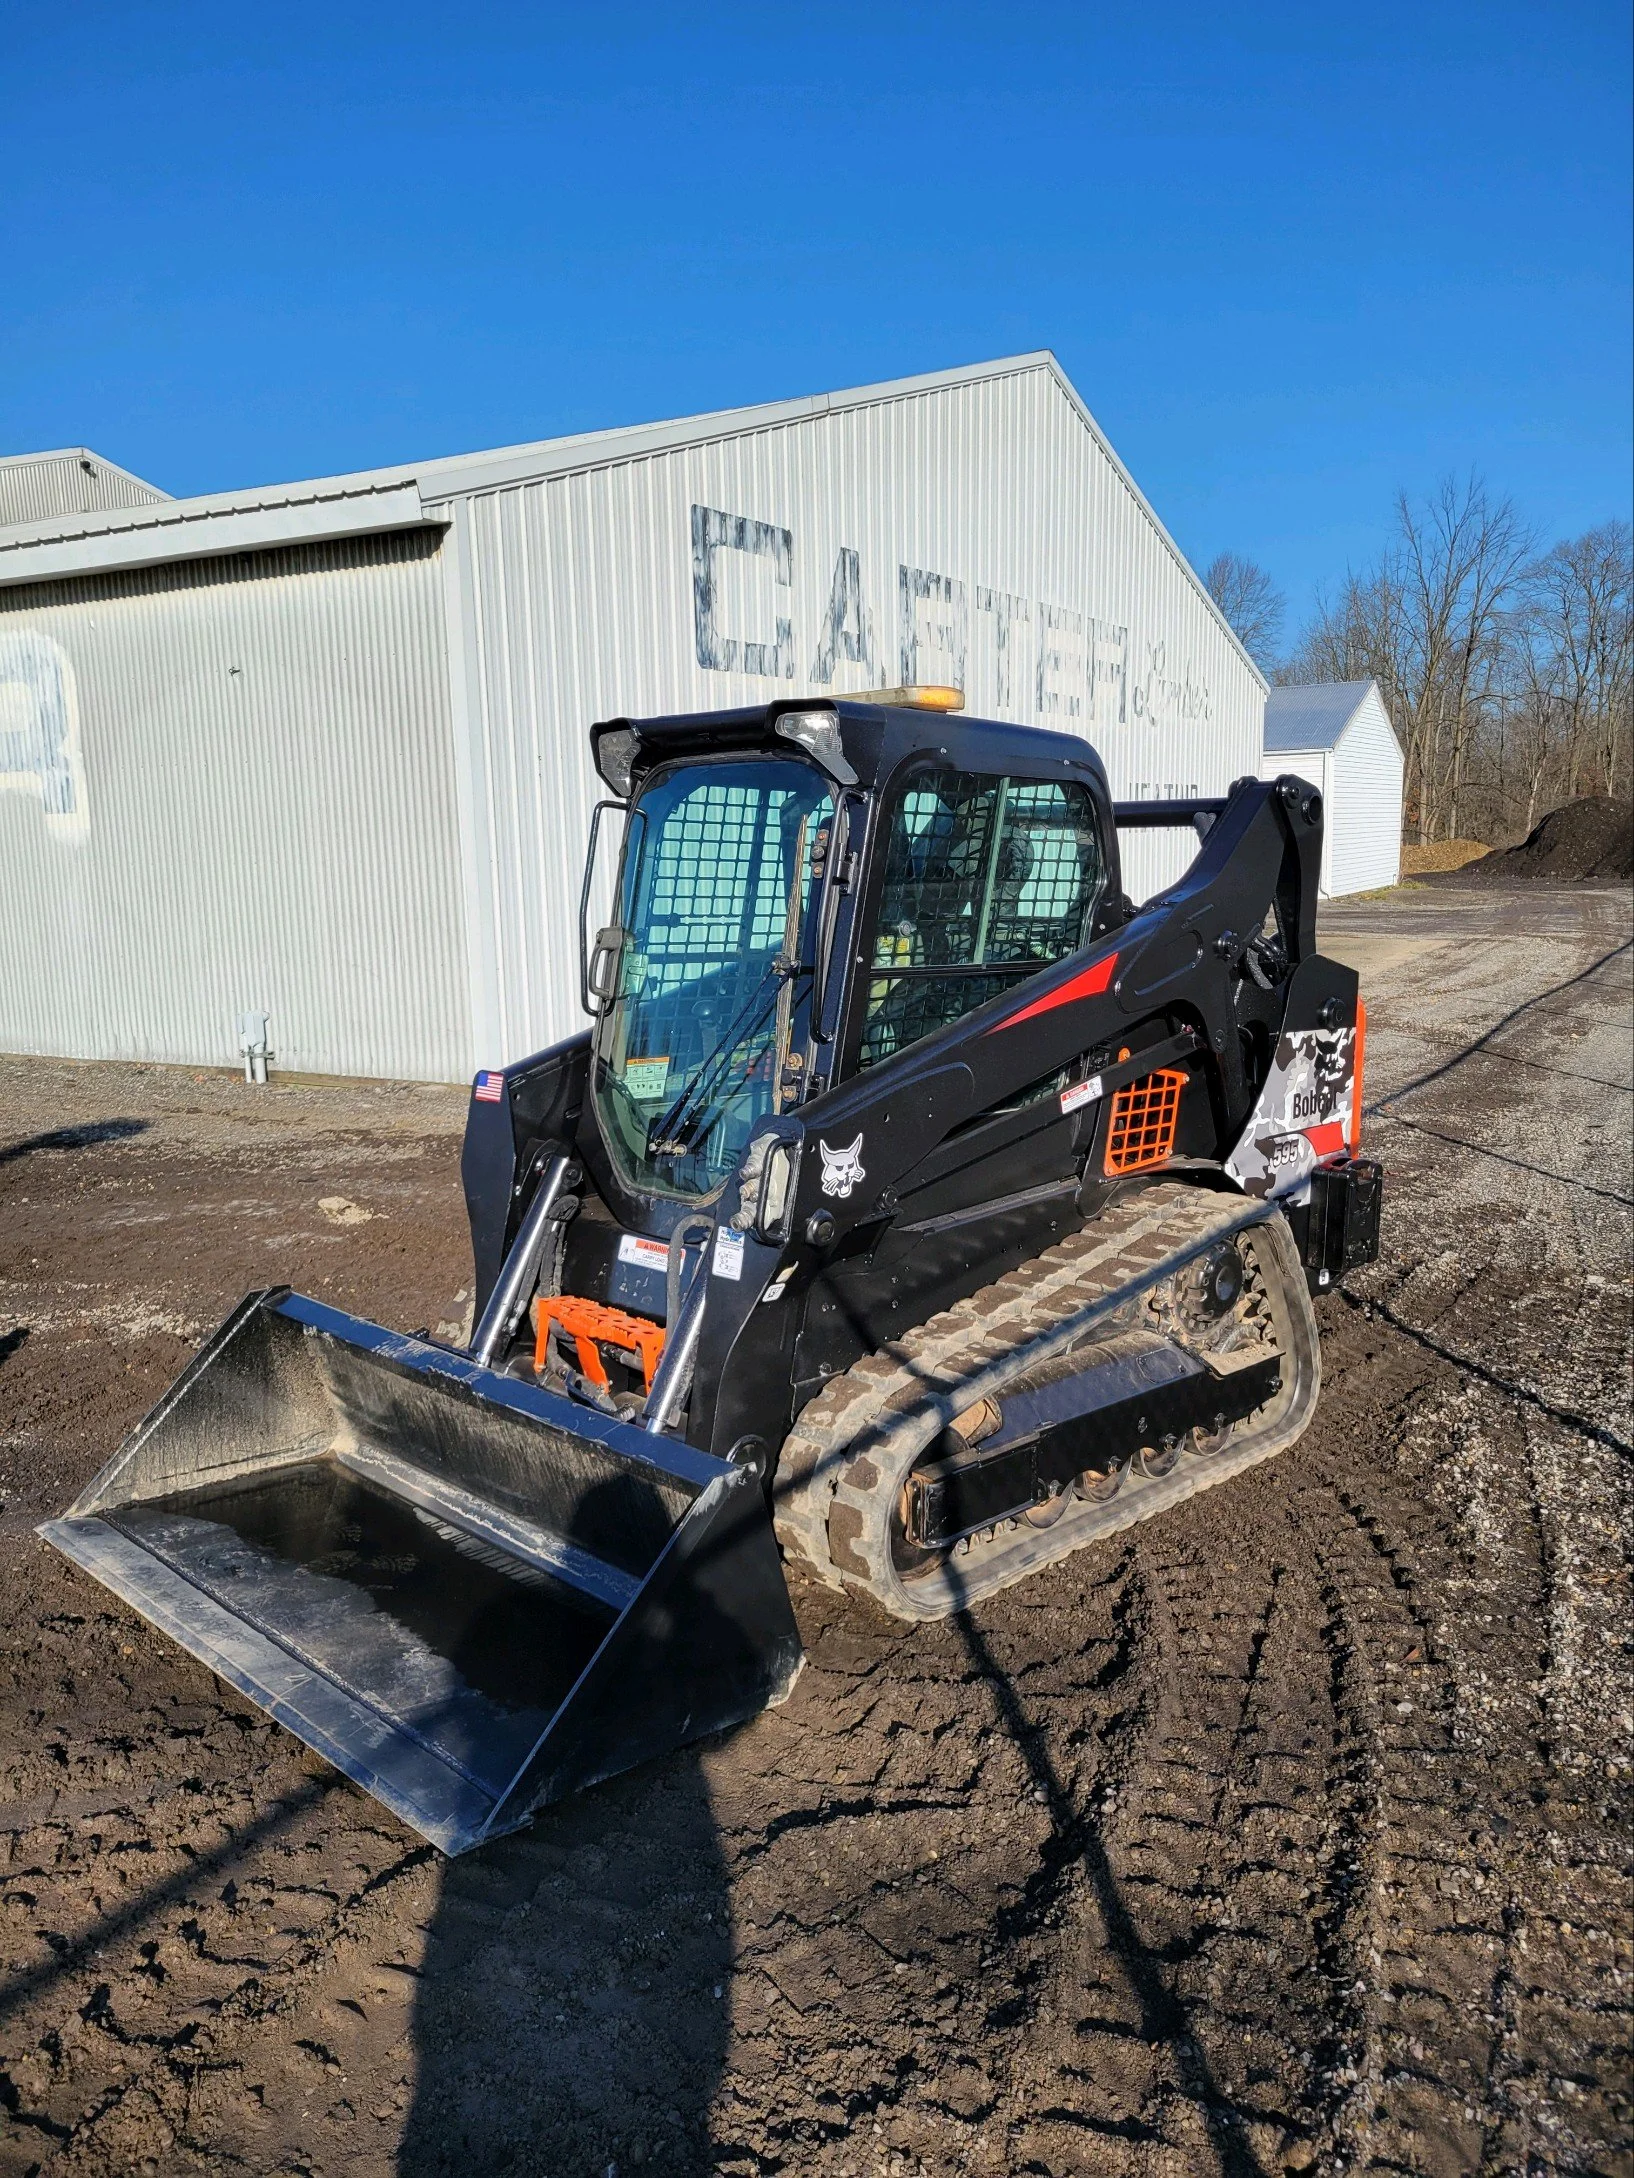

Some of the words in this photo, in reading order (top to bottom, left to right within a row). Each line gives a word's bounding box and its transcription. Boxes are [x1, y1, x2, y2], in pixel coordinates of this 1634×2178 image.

[690, 503, 1128, 724] CARTER
[1293, 1087, 1337, 1119] Bobcat
[1273, 1139, 1300, 1168] 595
